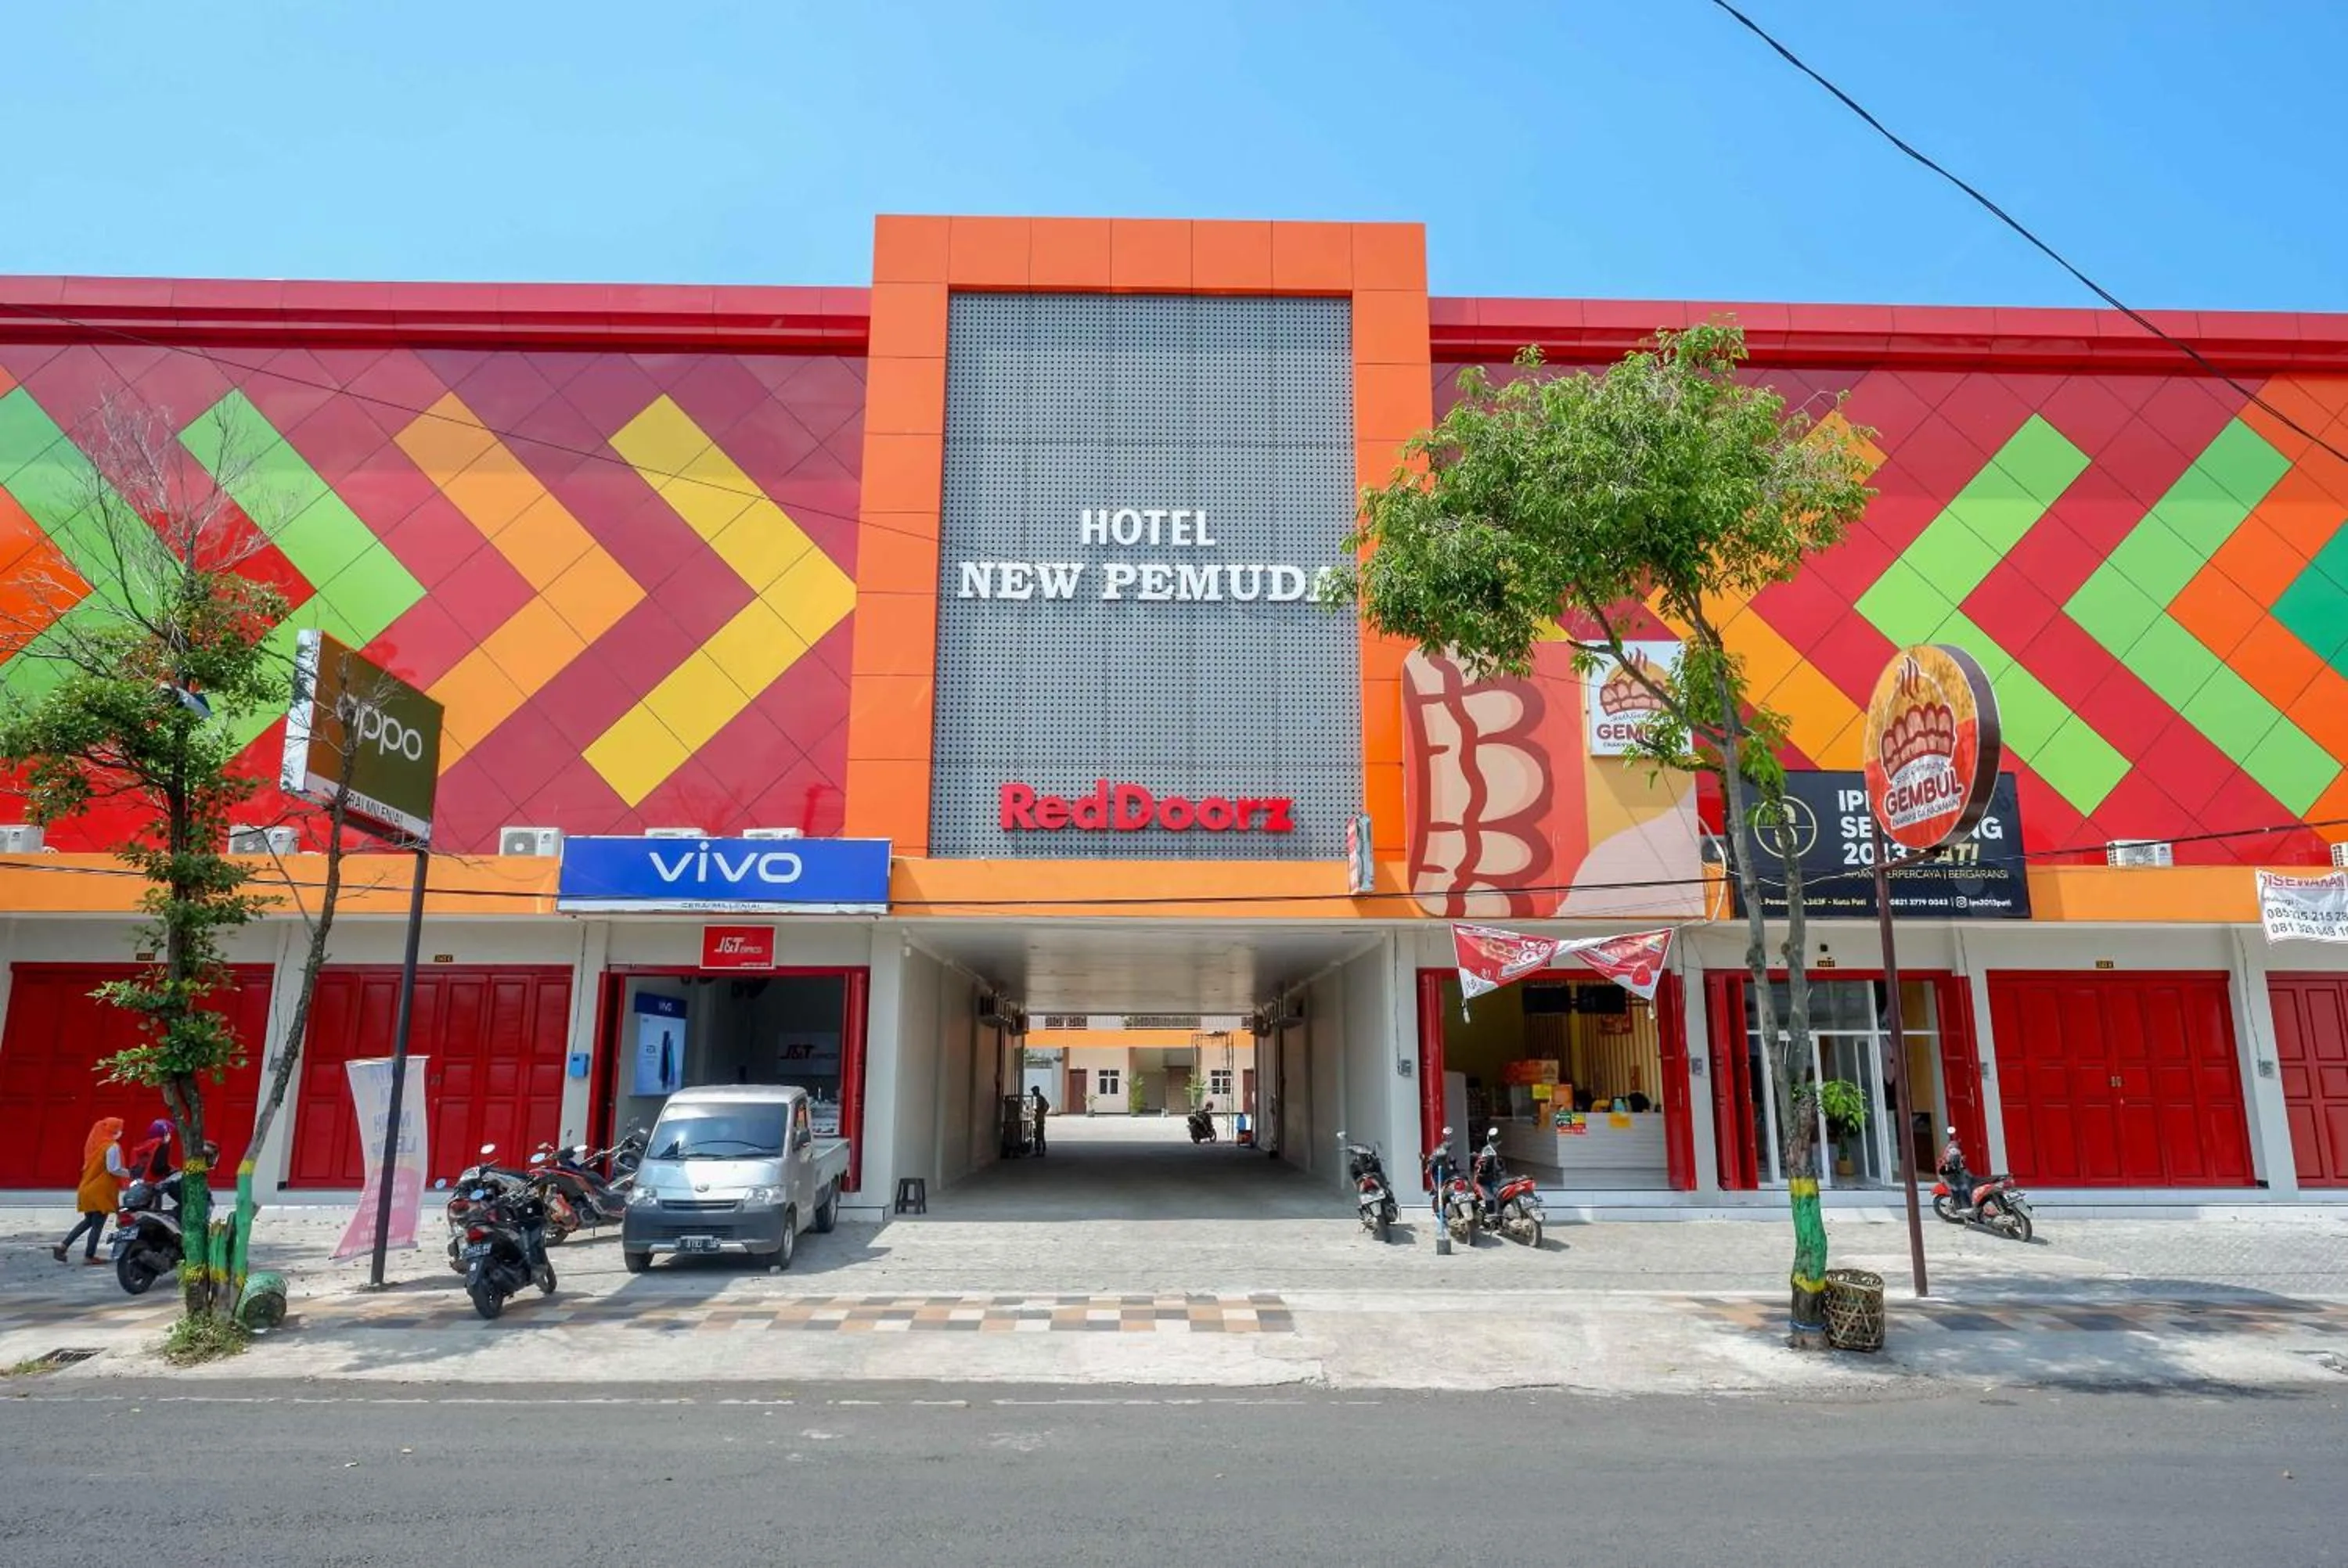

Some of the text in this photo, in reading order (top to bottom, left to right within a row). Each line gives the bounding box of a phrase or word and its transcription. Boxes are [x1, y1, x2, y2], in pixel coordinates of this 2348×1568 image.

[1082, 509, 1215, 546] HOTEL
[957, 562, 1085, 600] NEW
[999, 779, 1295, 833] RedDoorz
[1885, 768, 1962, 815] GEMBUL
[649, 841, 802, 883] vivo
[1886, 869, 1941, 879] ERPERCAYA
[1948, 869, 2009, 879] BERGARANSI
[713, 937, 746, 954] J&T
